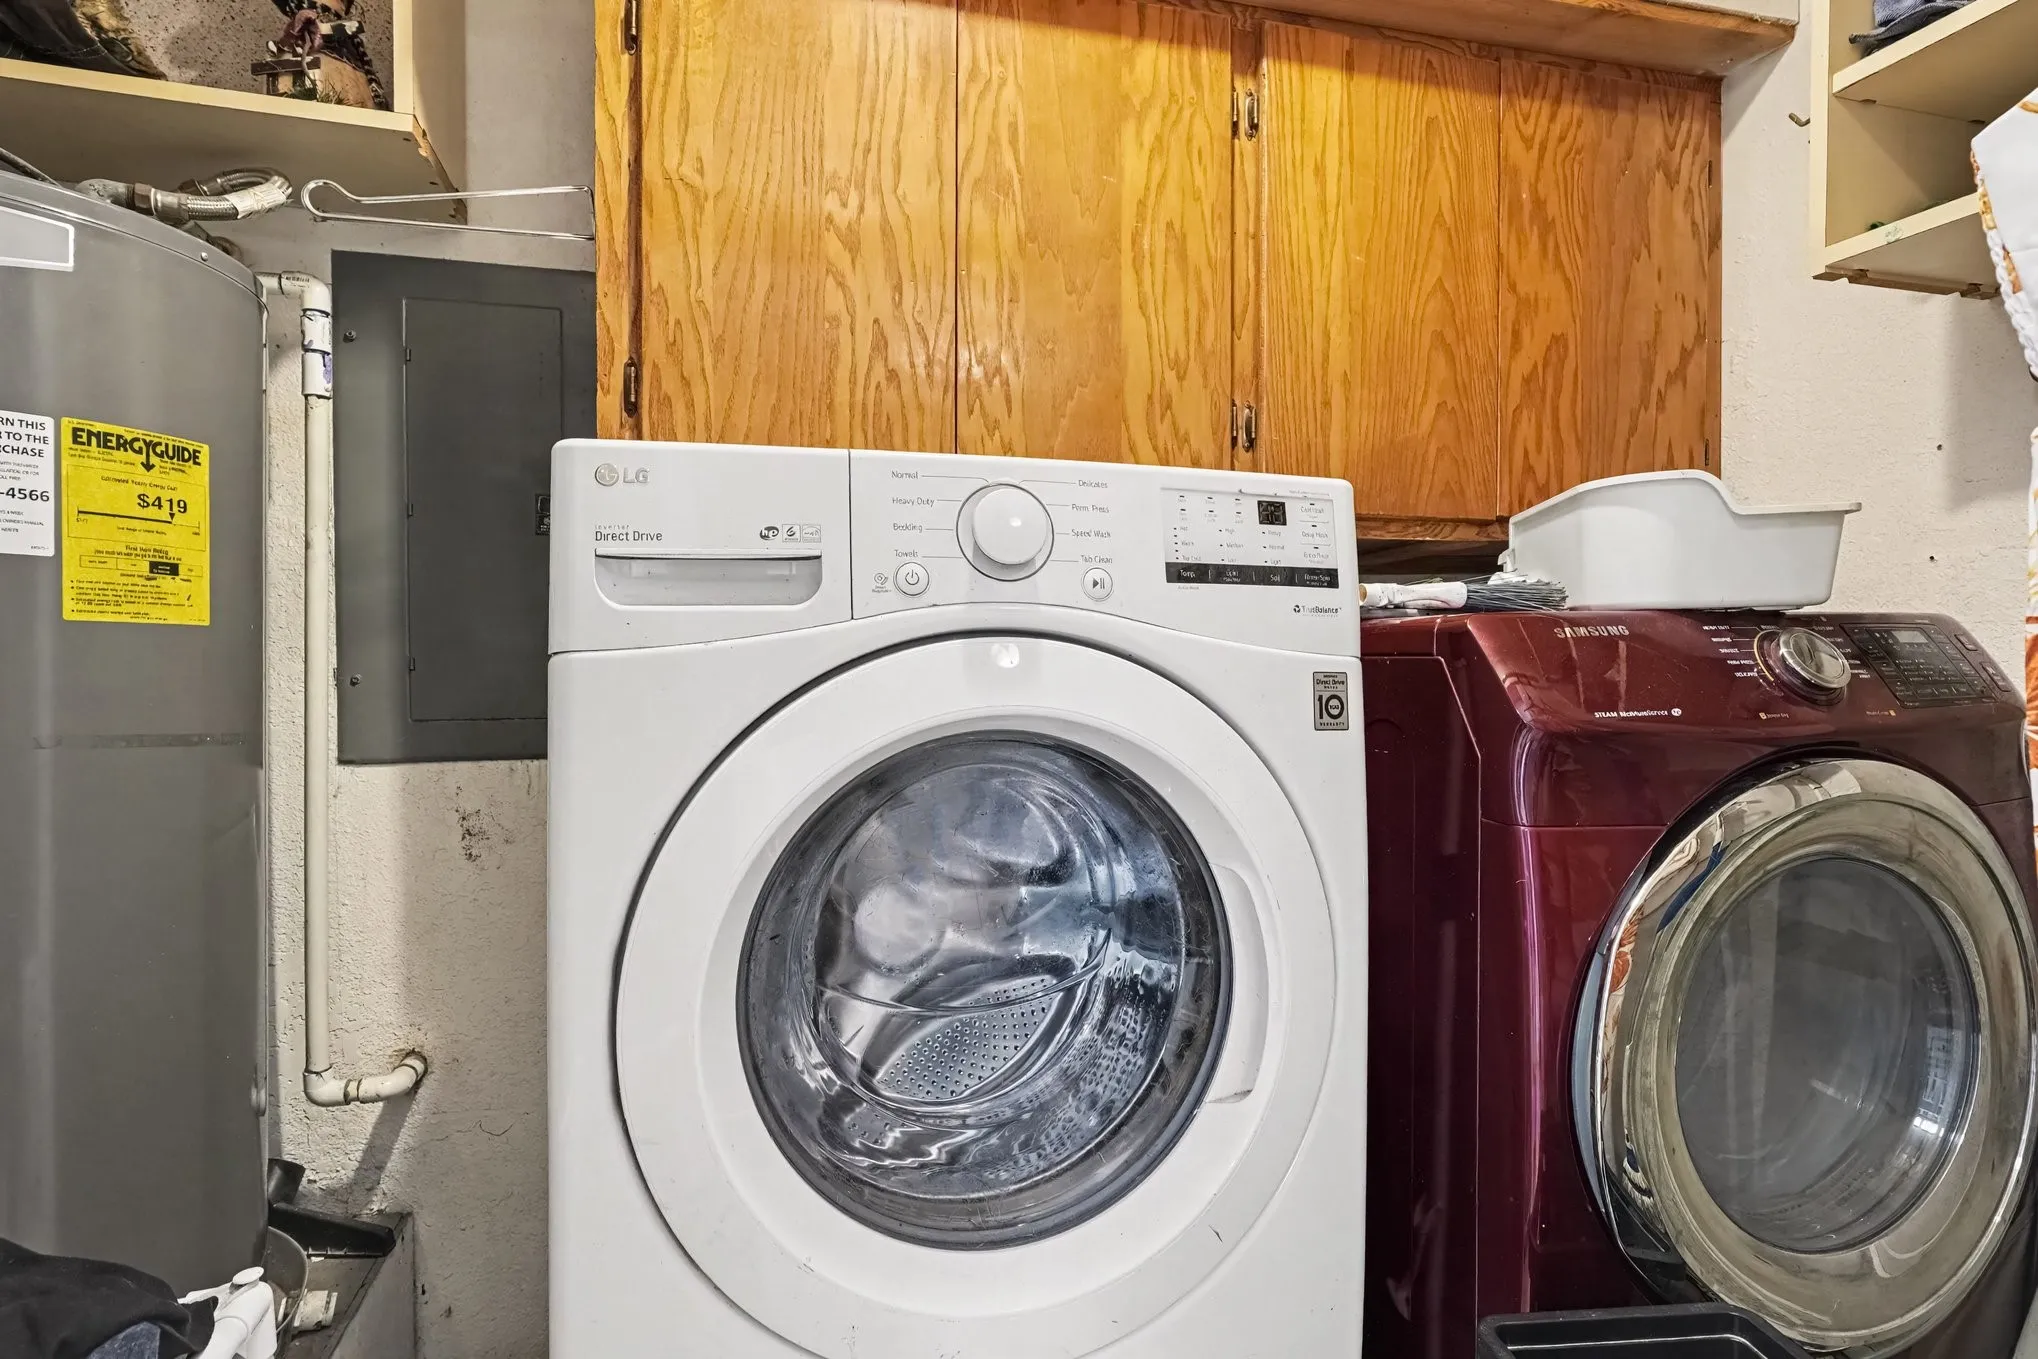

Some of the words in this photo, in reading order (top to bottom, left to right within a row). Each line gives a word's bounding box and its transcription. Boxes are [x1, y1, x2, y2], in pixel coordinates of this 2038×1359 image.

[17, 418, 45, 430] THIS
[4, 431, 22, 441] TO
[25, 433, 49, 445] THE
[623, 467, 650, 484] LG
[891, 470, 918, 479] Normal
[137, 493, 187, 514] $419
[892, 497, 914, 506] Heavy
[595, 530, 630, 541] Direct
[633, 530, 663, 541] Drive
[1554, 625, 1629, 638] SAMSUNG
[1317, 694, 1345, 720] 10
